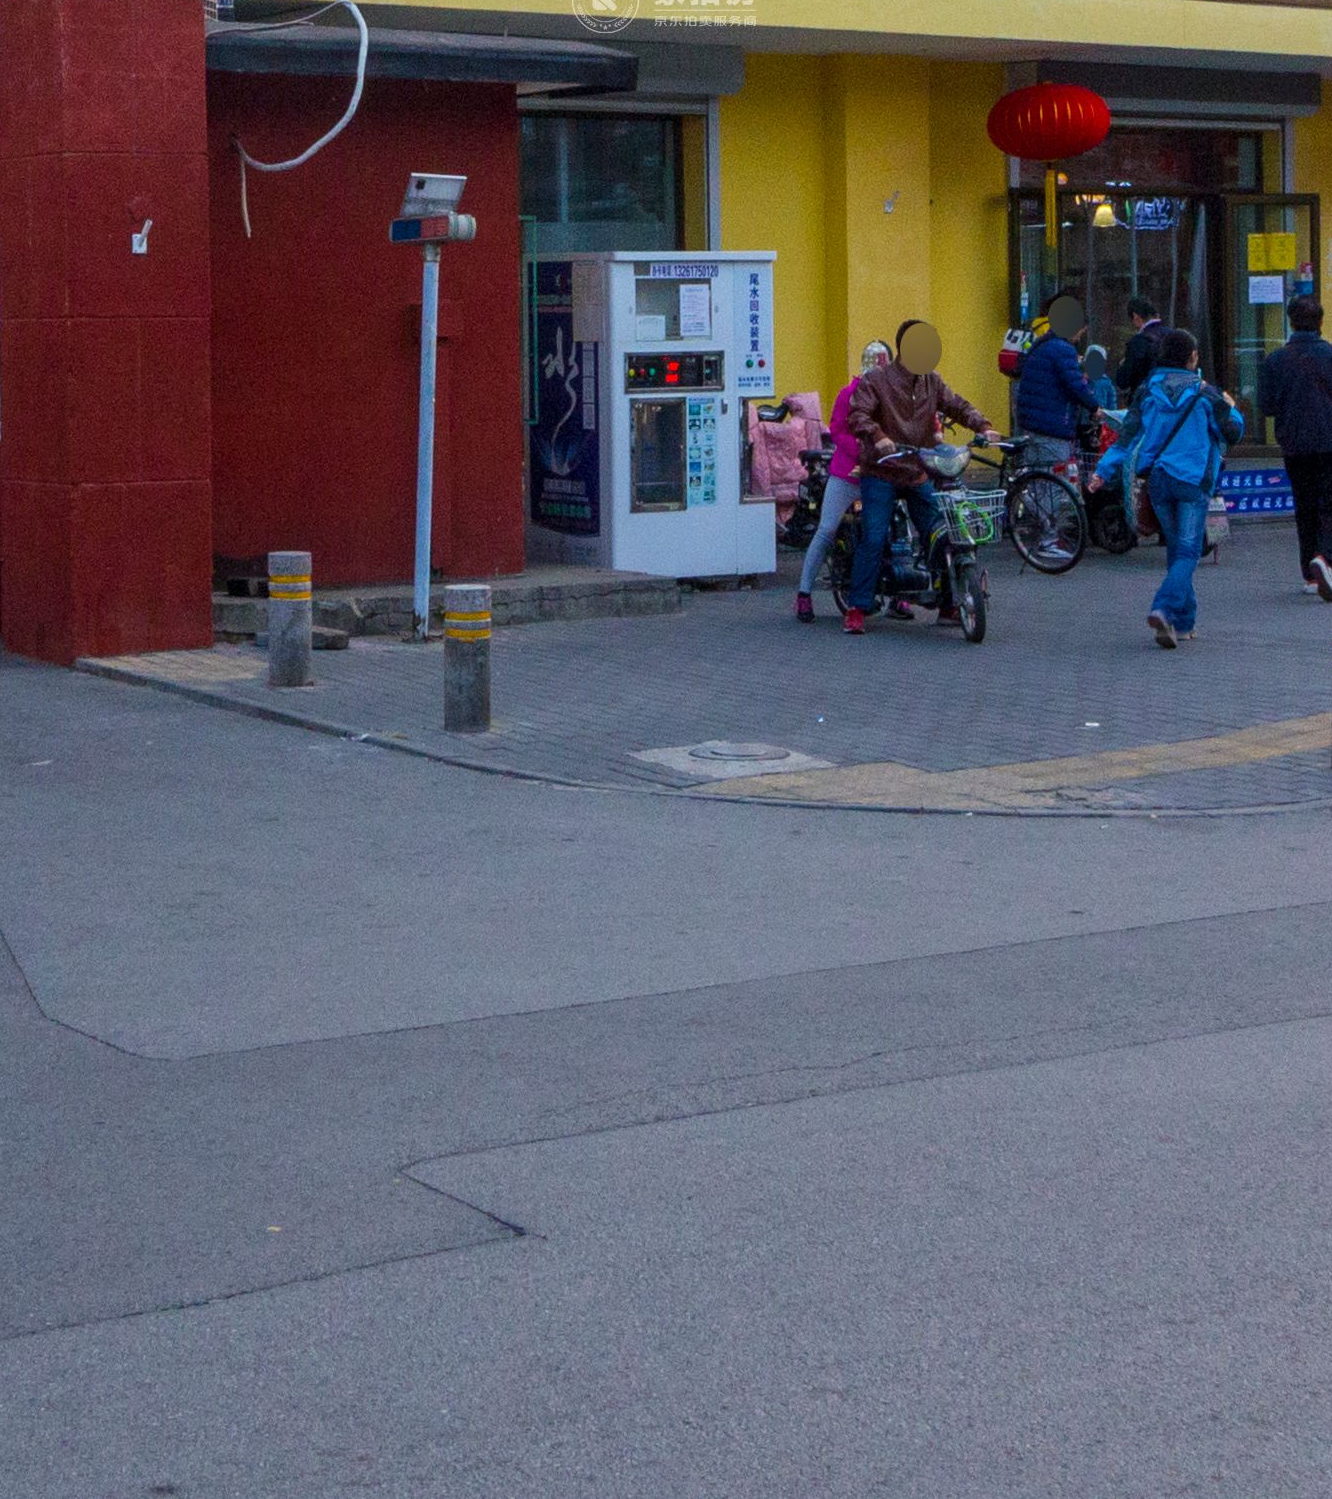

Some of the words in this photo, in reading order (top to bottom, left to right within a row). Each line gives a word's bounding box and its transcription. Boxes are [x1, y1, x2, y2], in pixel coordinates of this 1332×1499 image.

[749, 273, 760, 352] 尾水回收装置
